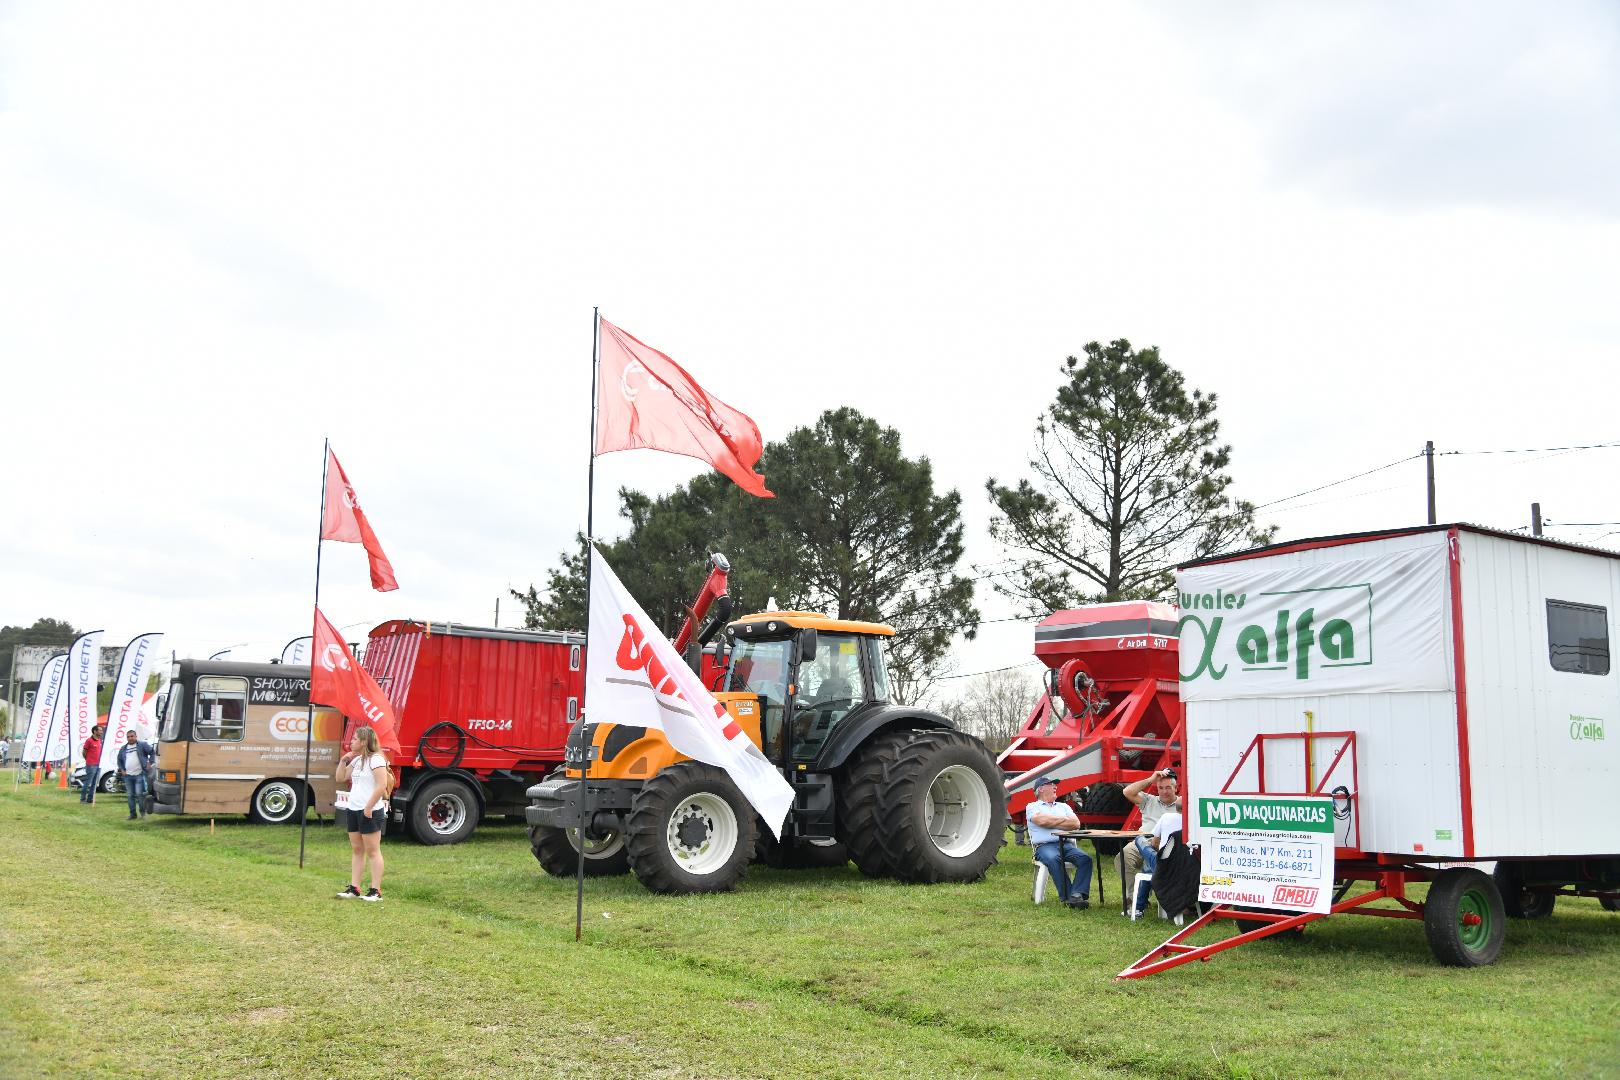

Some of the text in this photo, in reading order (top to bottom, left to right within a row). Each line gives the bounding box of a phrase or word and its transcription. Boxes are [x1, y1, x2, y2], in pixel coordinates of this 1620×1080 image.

[1178, 588, 1247, 610] urales
[1236, 607, 1355, 680] alfa
[79, 638, 92, 740] TOYOTA PICHETTI
[115, 700, 133, 745] TOYOTA
[126, 638, 150, 698] PICHETTI
[253, 678, 311, 690] SHOWRO
[35, 659, 64, 743] TOYOTA PICHETTI
[59, 705, 69, 742] TOYOT
[1206, 802, 1327, 825] MD MAQUINARIAS
[1220, 844, 1237, 854] Ruta
[1240, 846, 1258, 855] Nac.
[1277, 848, 1294, 858] Km.
[1296, 849, 1313, 859] 211
[1219, 857, 1313, 872] Cel. 02355-15-64-6871
[1211, 890, 1265, 904] CRUCIANELLI
[1275, 888, 1315, 904] OMBU
